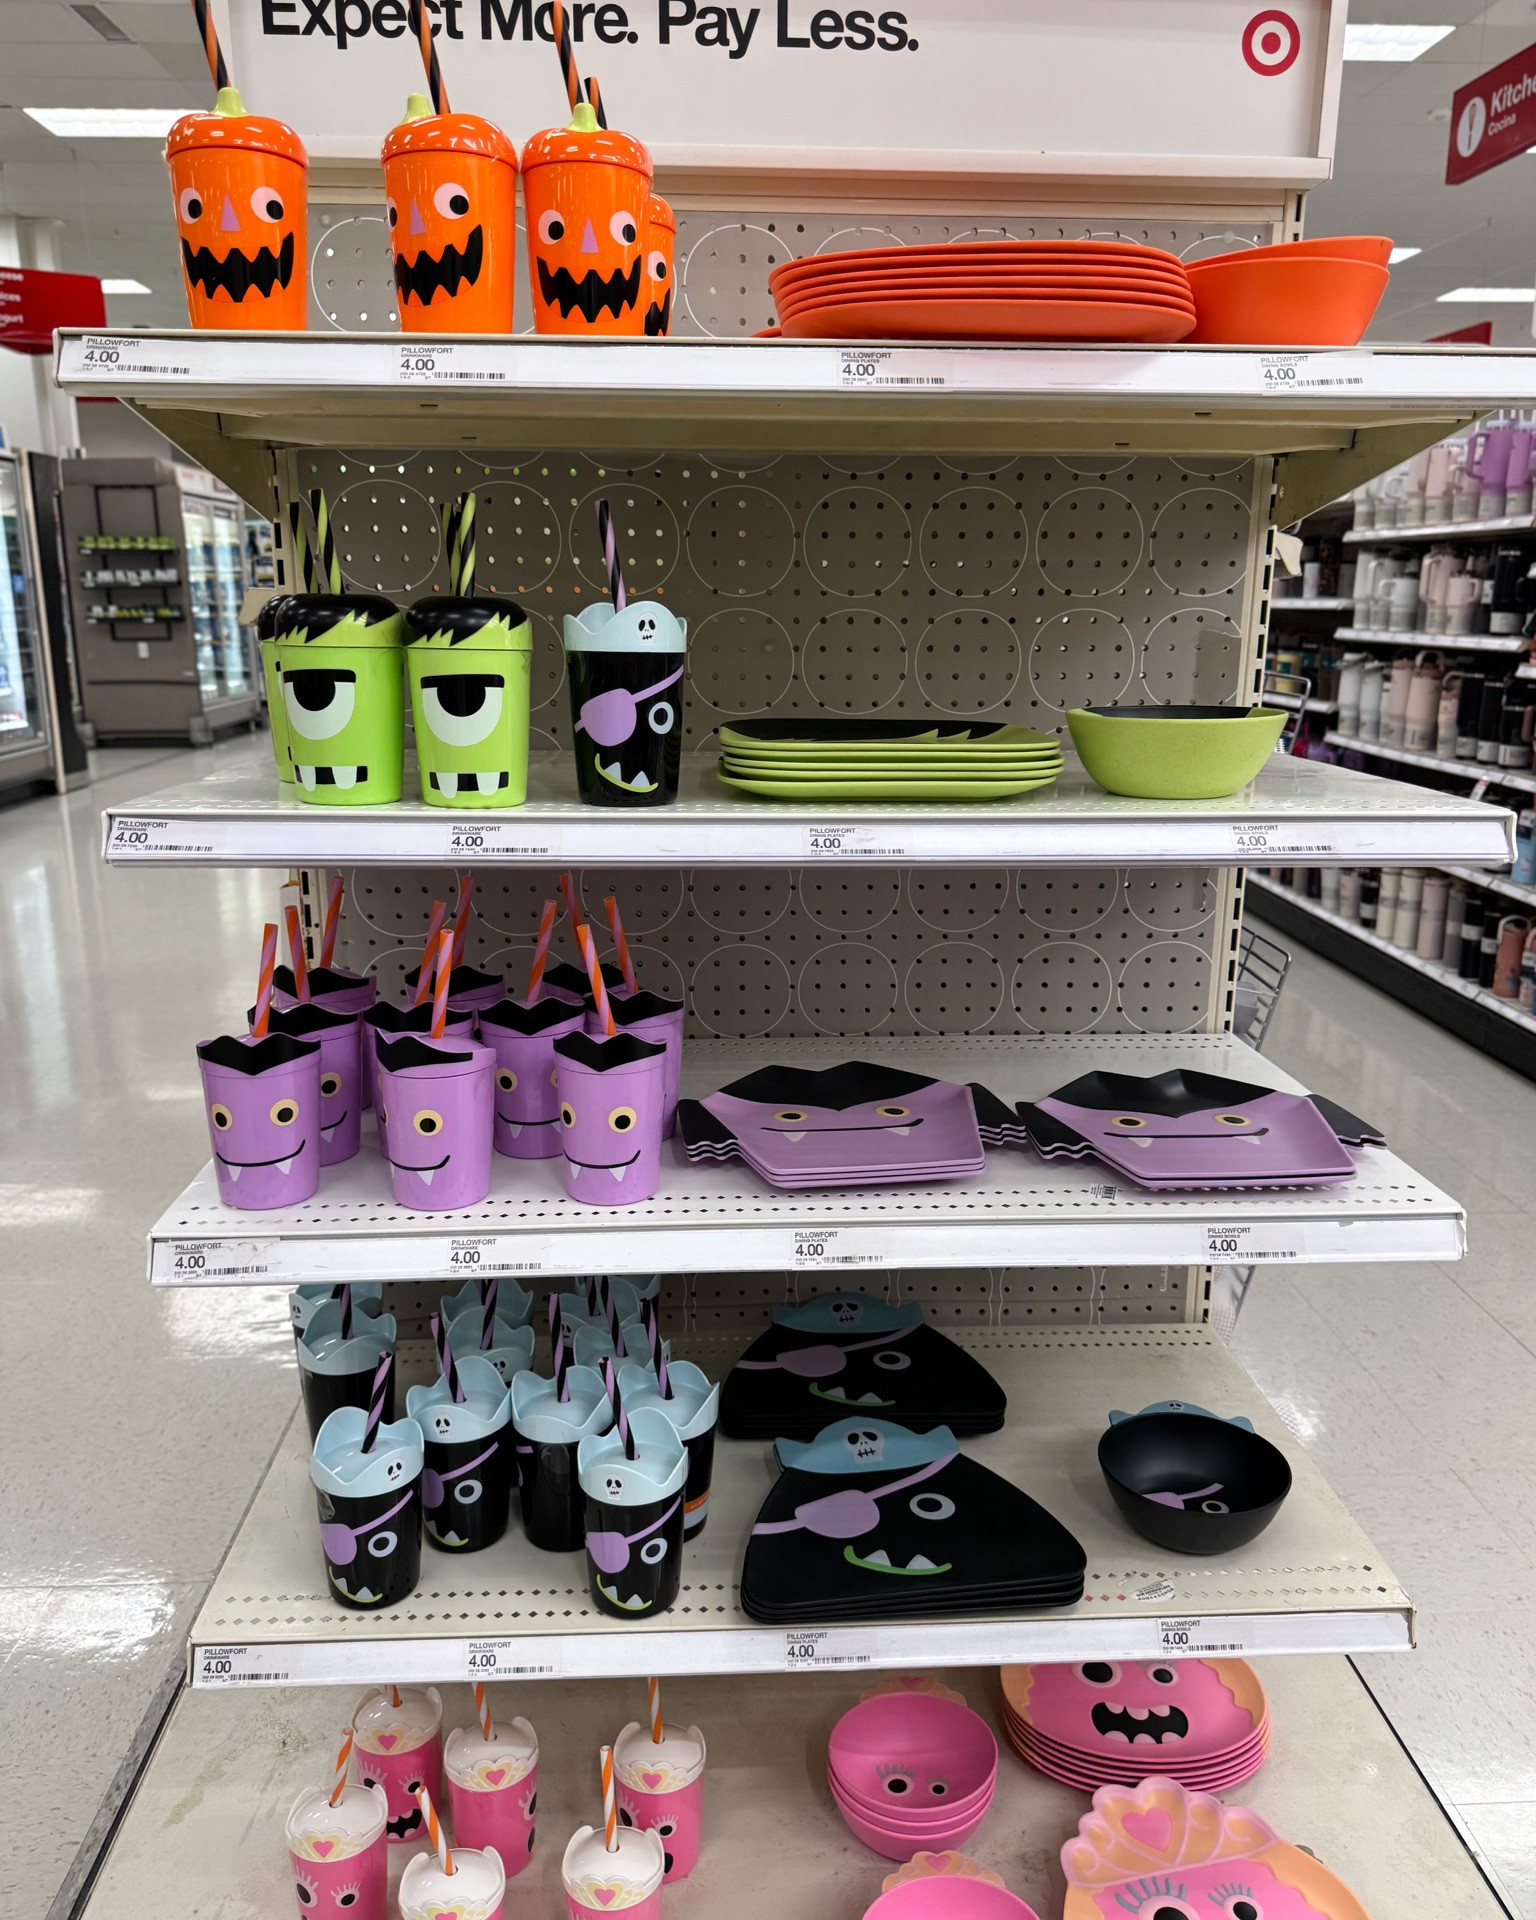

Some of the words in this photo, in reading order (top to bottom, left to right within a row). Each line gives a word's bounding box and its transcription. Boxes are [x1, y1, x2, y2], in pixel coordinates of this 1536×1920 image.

[262, 0, 464, 50] Expect
[481, 0, 639, 45] More.
[658, 0, 760, 60] Pay
[776, 0, 919, 52] Less.
[87, 338, 141, 347] PILLOWFORT
[84, 350, 120, 363] 4.00
[401, 359, 435, 371] 4.00
[843, 364, 875, 376] 4.00
[1264, 368, 1295, 380] 4.00
[115, 832, 148, 843] 4.00
[452, 836, 483, 846] 4.00
[811, 838, 840, 848] 4.00
[1237, 836, 1266, 846] 4.00
[796, 1244, 823, 1256] 4.00
[1209, 1240, 1237, 1251] 4.00
[175, 1256, 205, 1269] 4.00
[451, 1251, 480, 1264] 4.00
[1163, 1633, 1188, 1644] 4.00
[788, 1645, 814, 1657] 4.00
[204, 1661, 231, 1673] 4.00
[469, 1655, 496, 1667] 4.00
